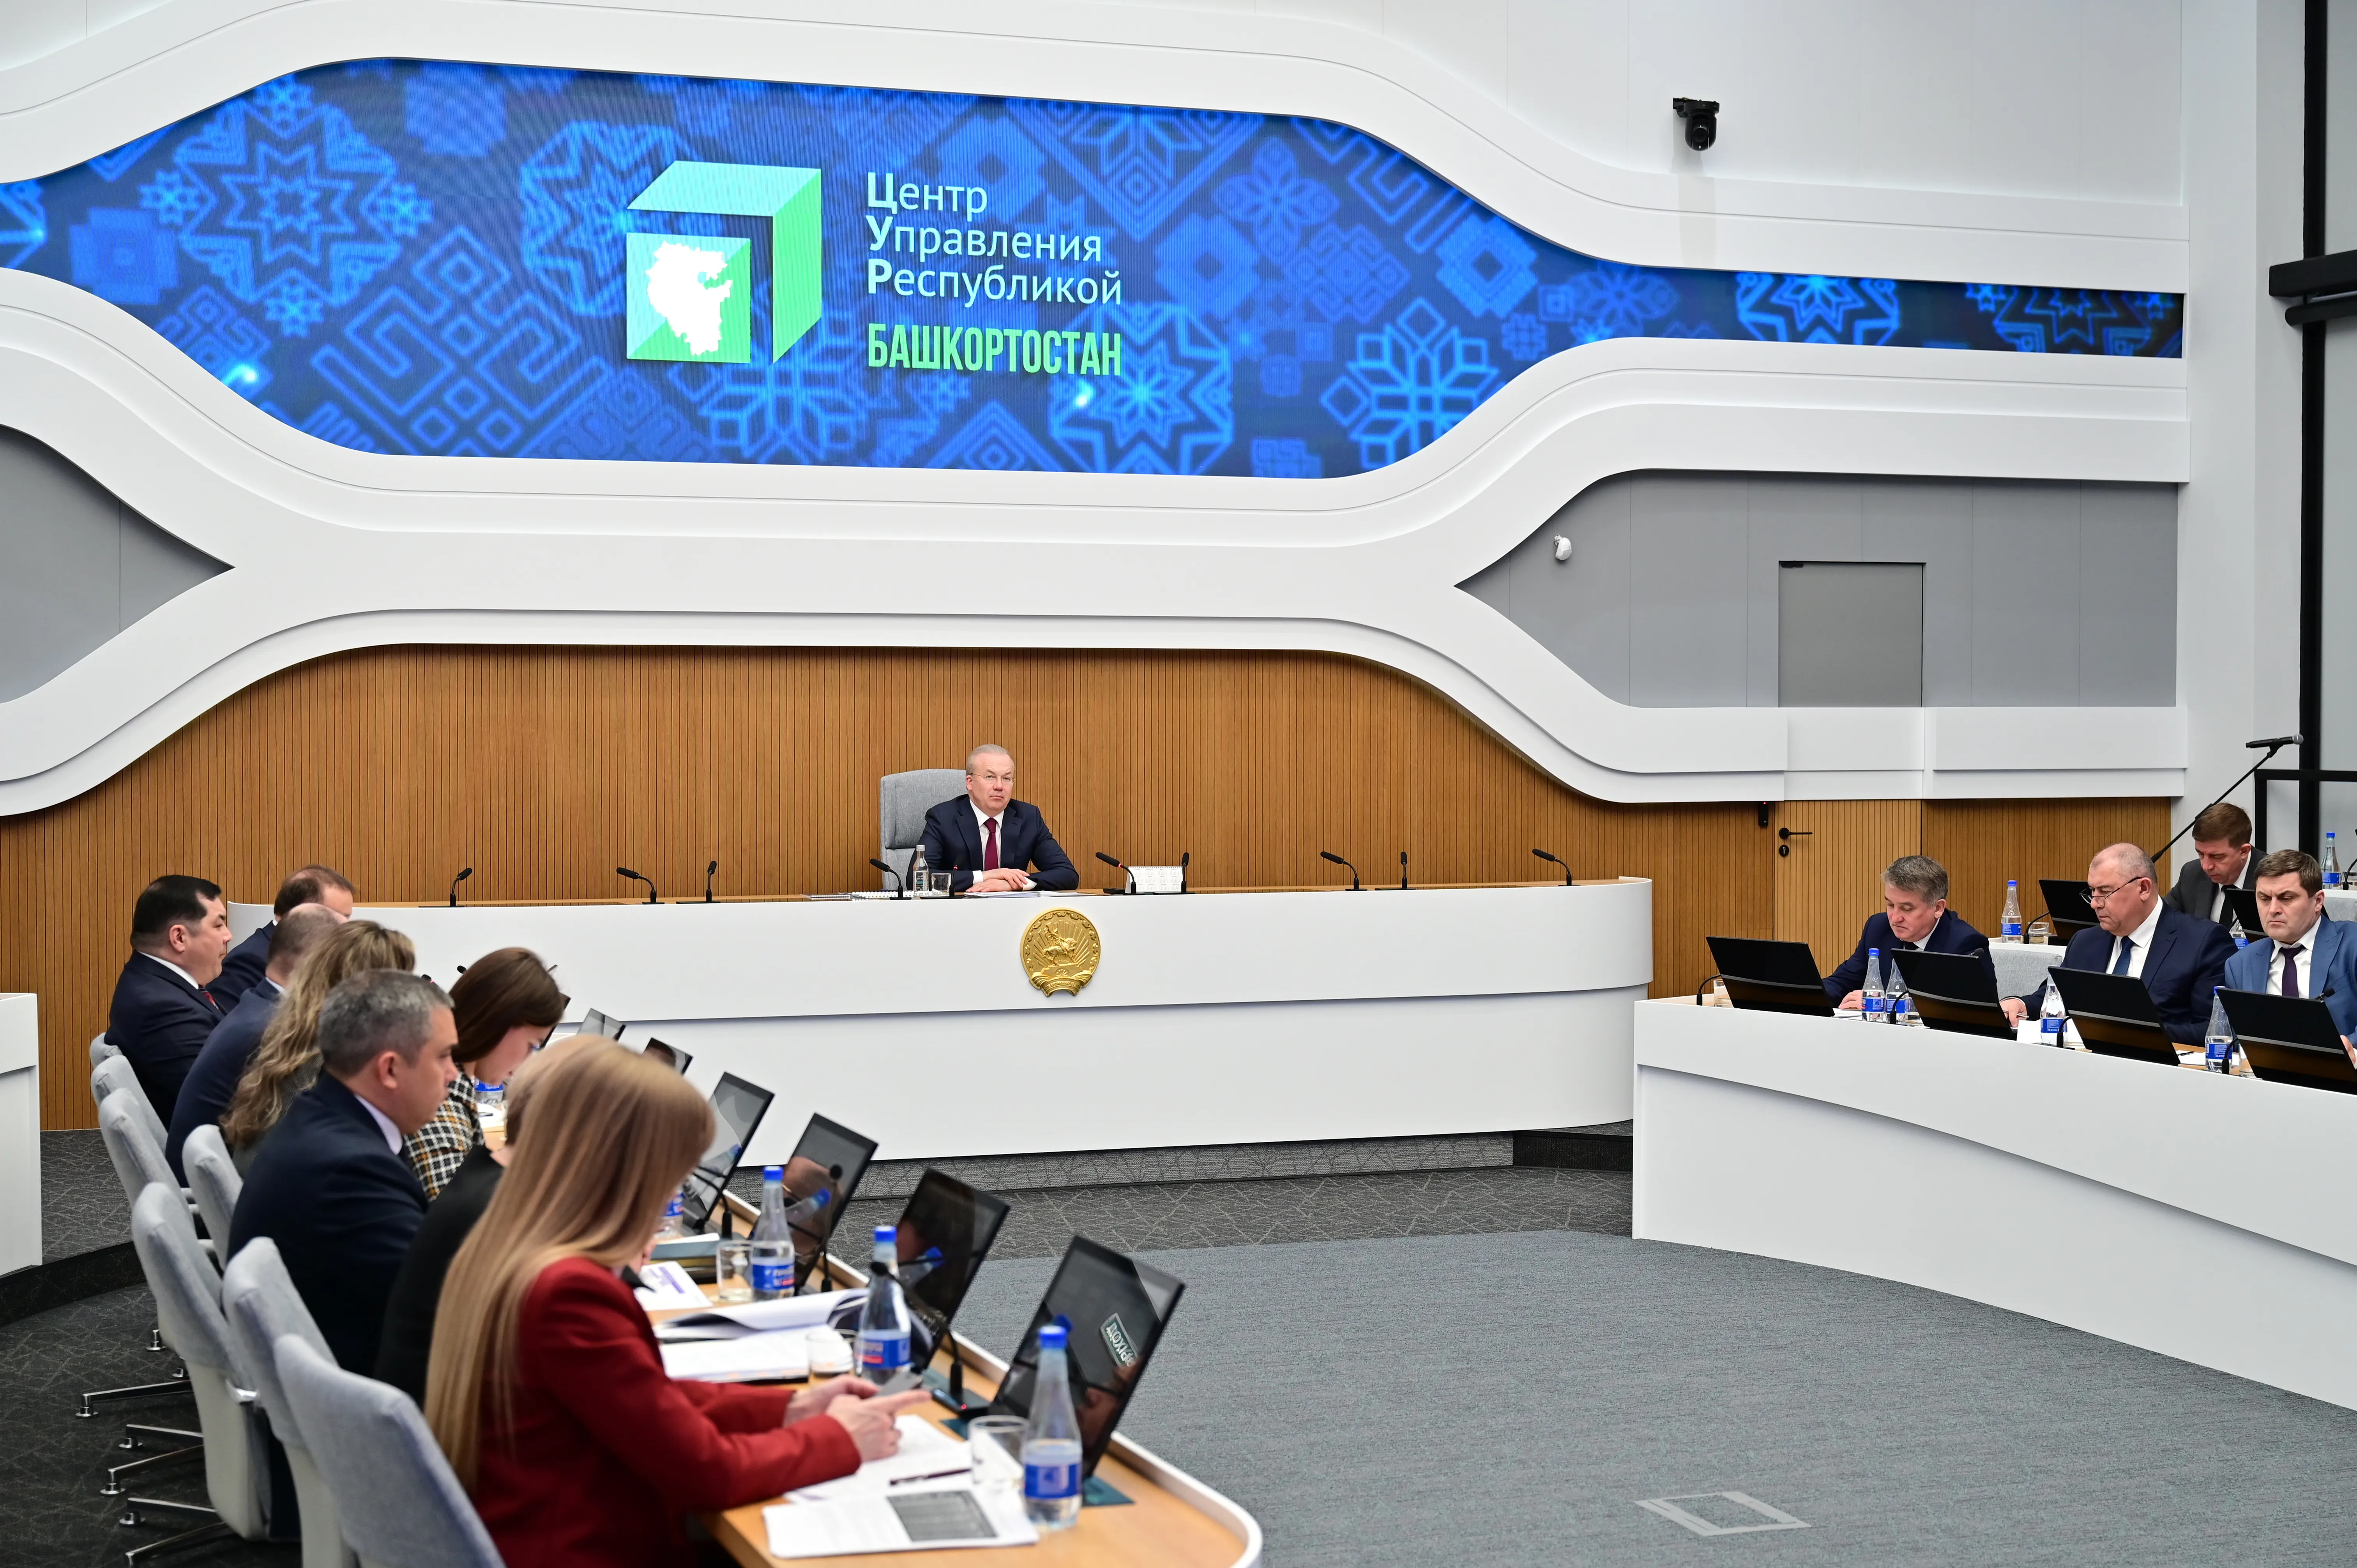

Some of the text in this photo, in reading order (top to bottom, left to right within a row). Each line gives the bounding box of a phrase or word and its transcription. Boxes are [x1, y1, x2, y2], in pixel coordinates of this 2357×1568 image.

[868, 172, 988, 222] Центр
[865, 215, 1101, 263] Управления
[868, 258, 1121, 308] Республикой
[868, 323, 1121, 376] БАШКОРТОСТАН
